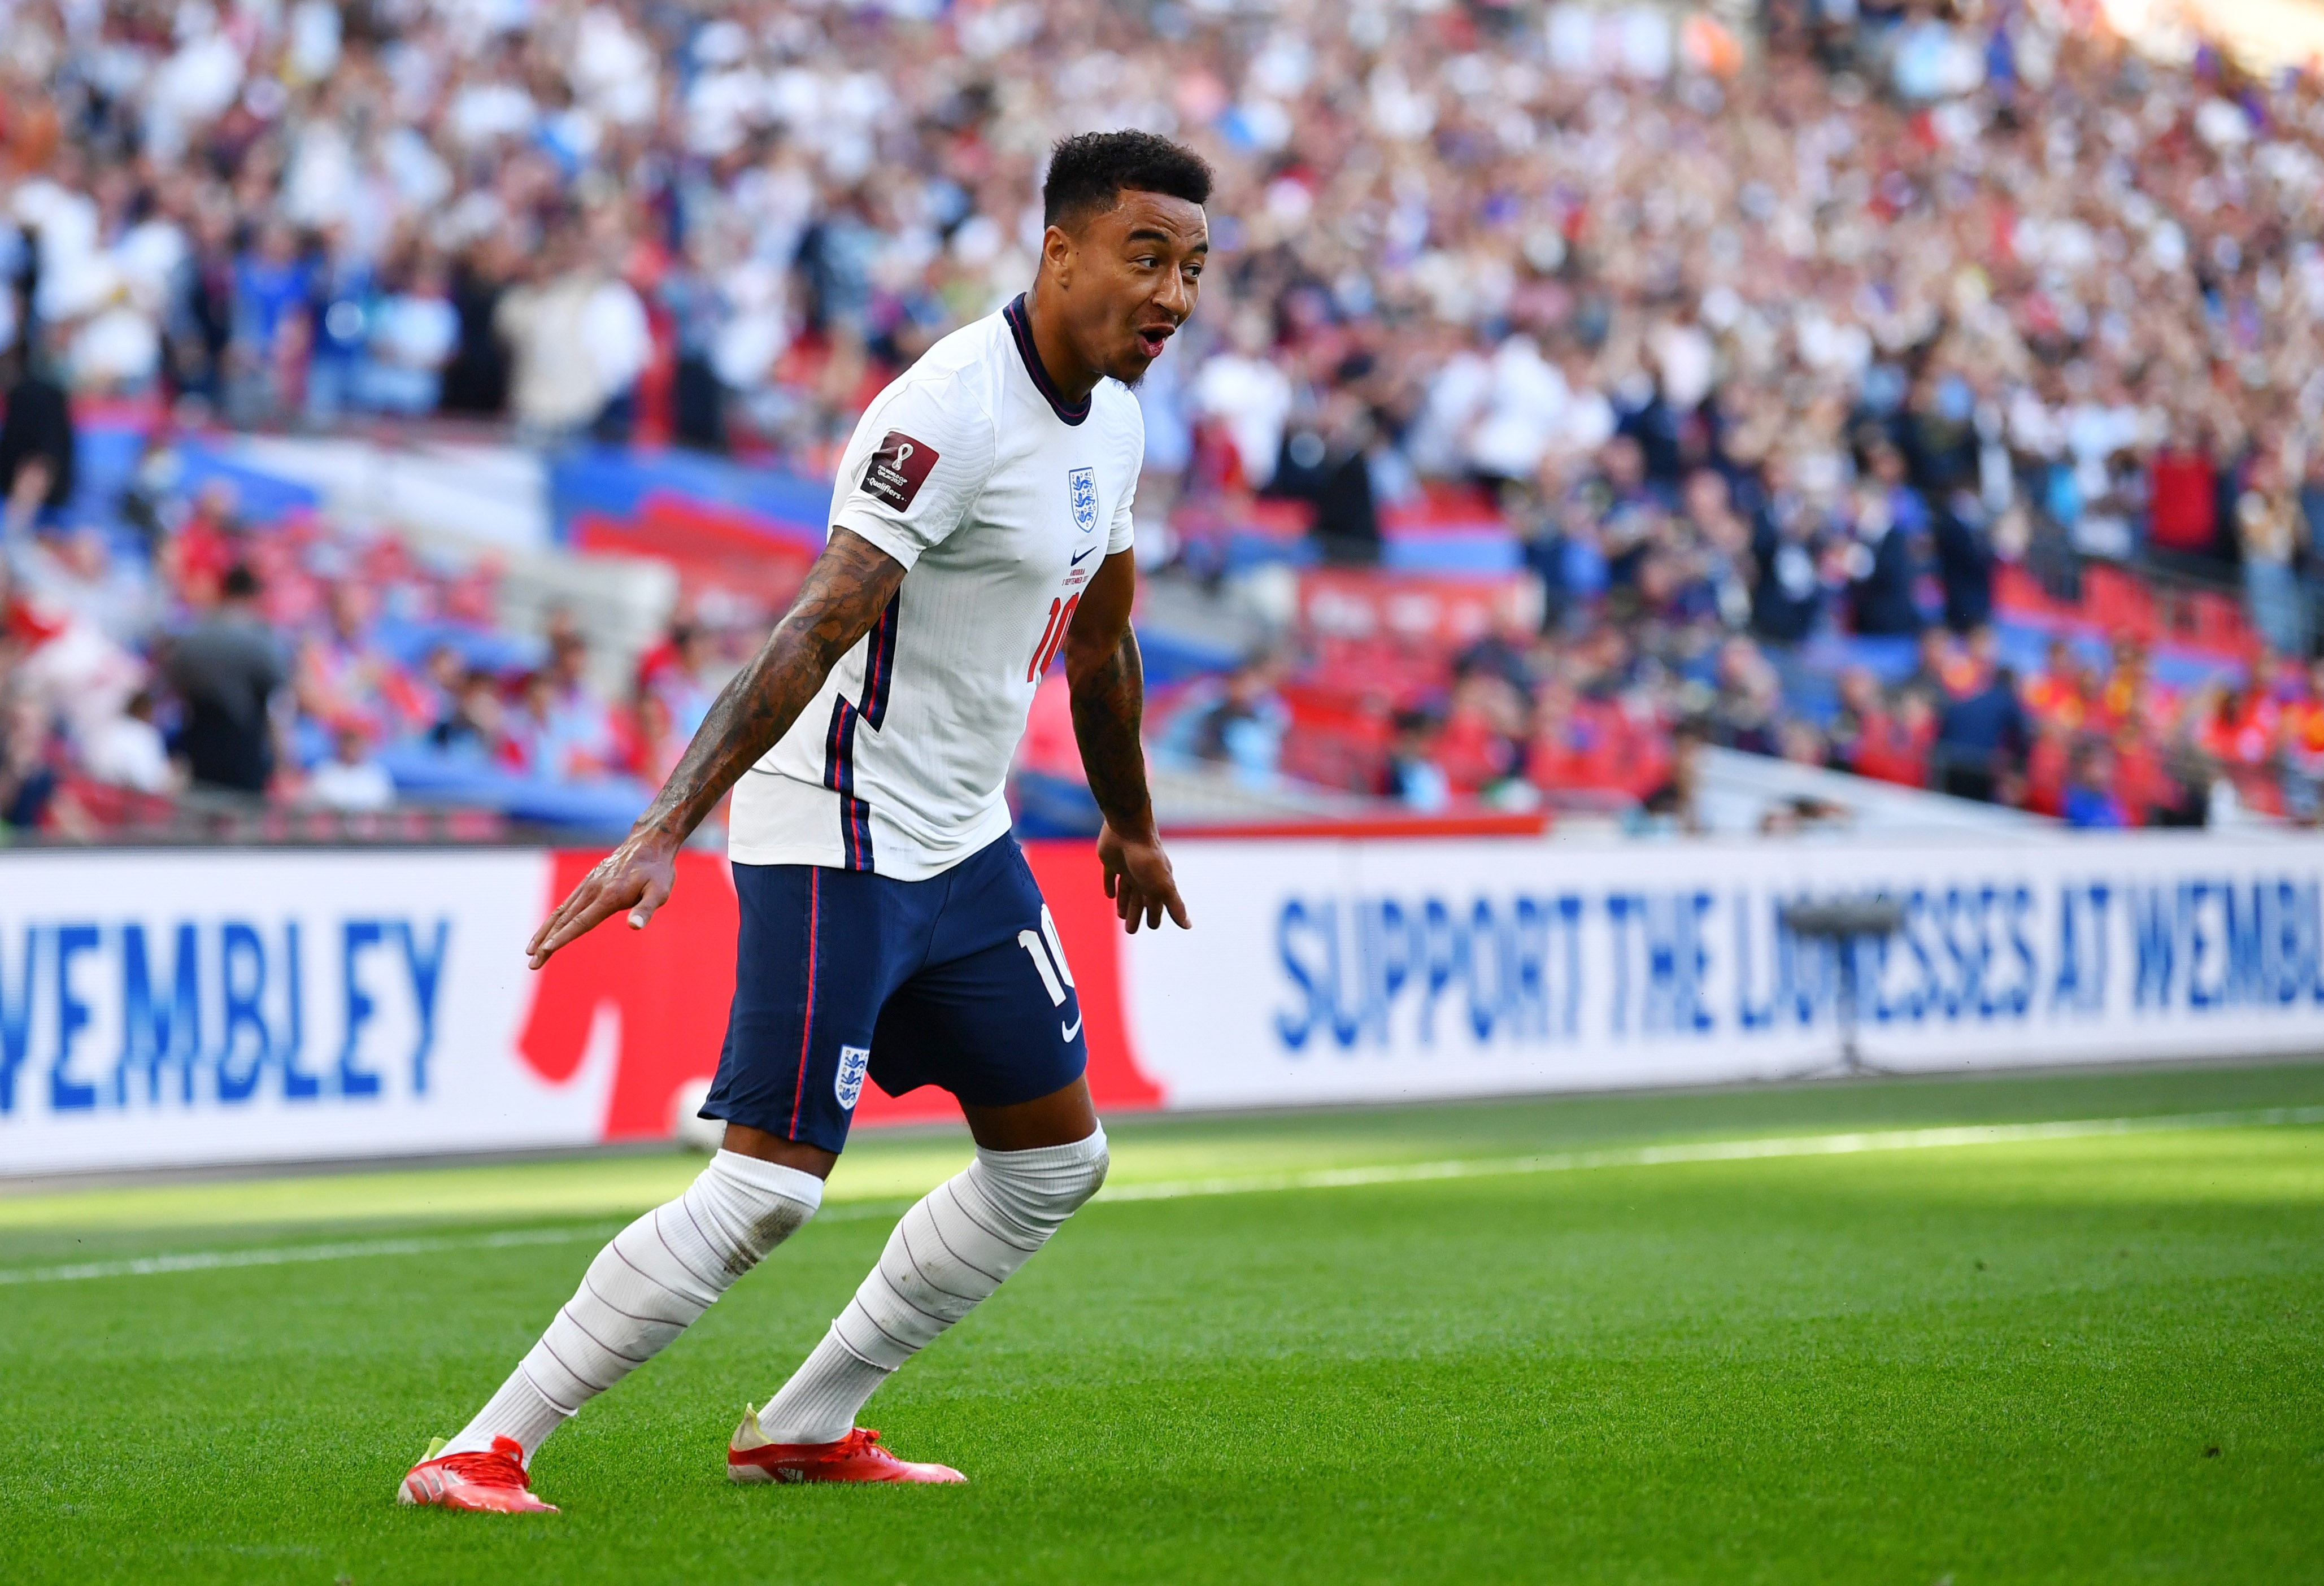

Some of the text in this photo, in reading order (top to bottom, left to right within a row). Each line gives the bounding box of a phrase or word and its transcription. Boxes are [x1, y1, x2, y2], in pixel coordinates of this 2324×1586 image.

[869, 477, 902, 499] Qualifiers
[1027, 591, 1079, 683] 10
[1017, 903, 1075, 1007] 10
[1277, 896, 1583, 1049] SUPPORT
[1605, 892, 1713, 1034] THE
[2051, 882, 2114, 1011] AT
